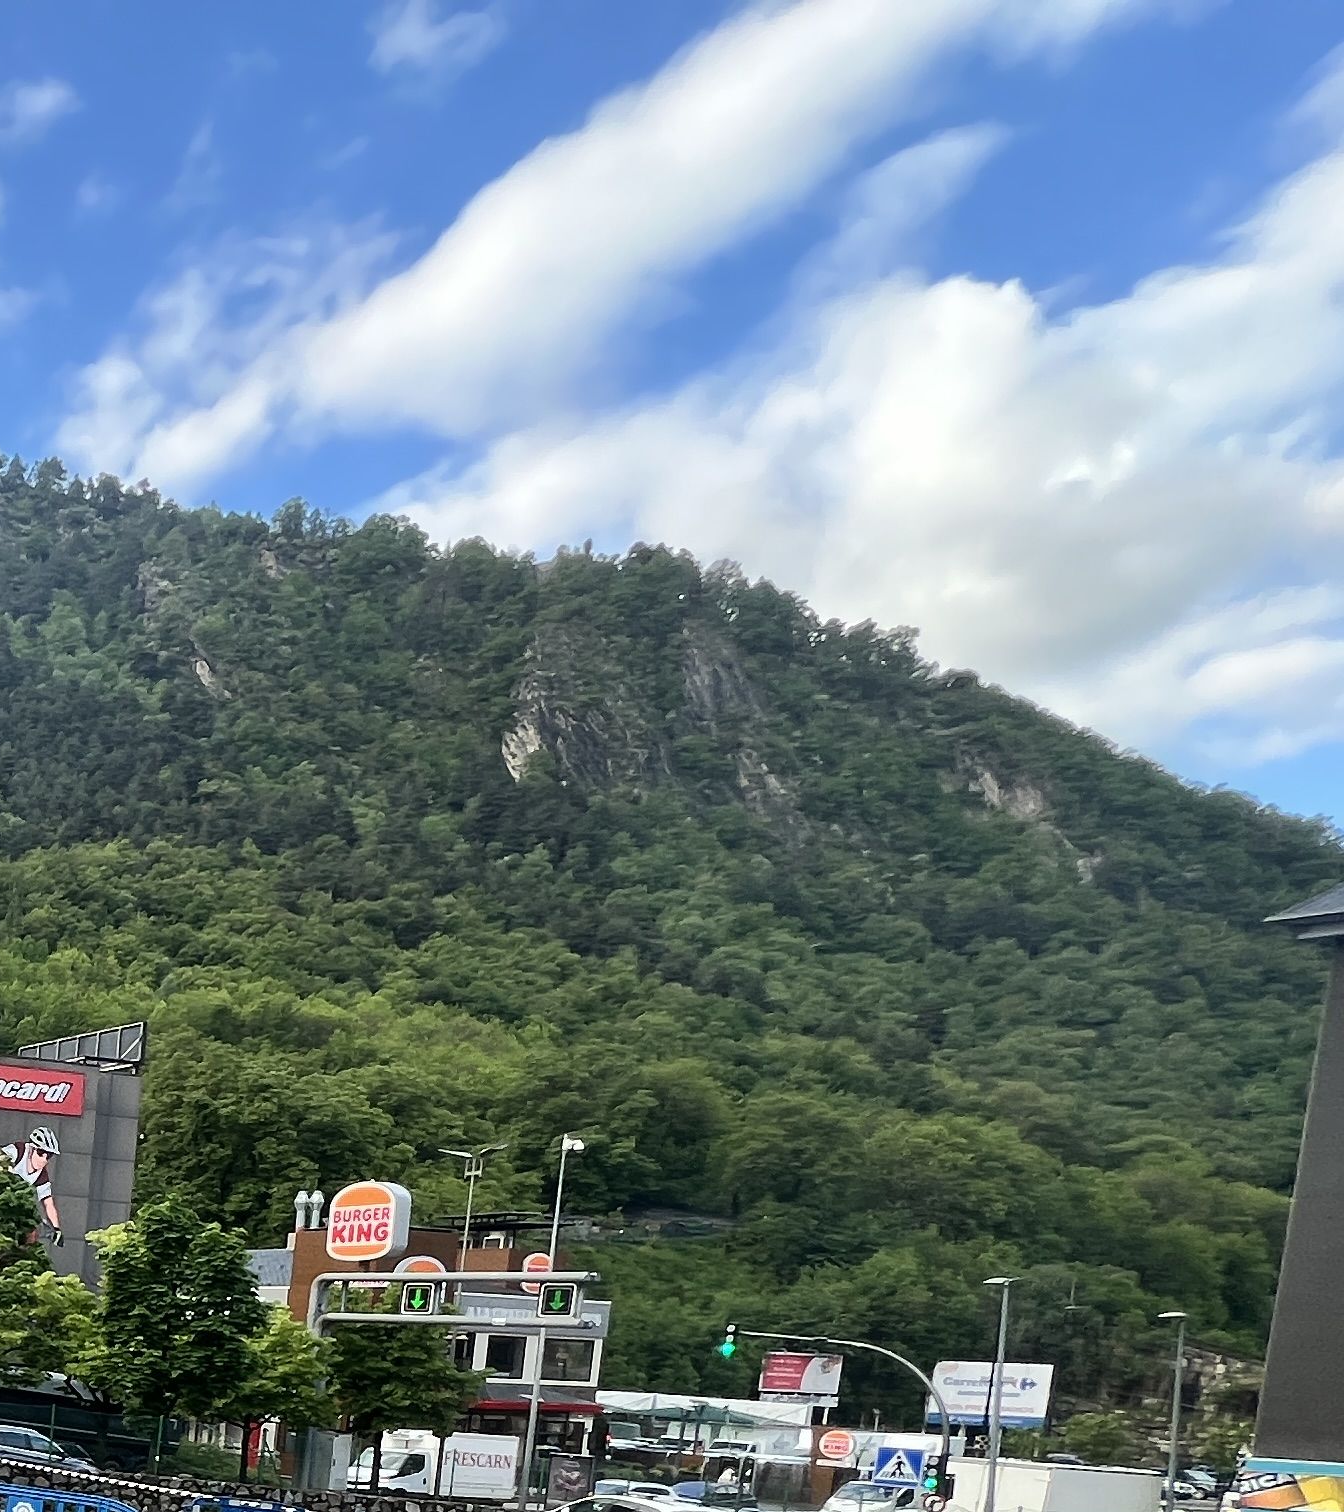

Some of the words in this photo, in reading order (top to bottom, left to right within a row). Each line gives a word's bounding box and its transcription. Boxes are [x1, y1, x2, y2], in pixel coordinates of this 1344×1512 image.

[334, 1208, 390, 1223] BURGER
[332, 1222, 389, 1243] KING
[443, 1450, 512, 1469] FRESCARN
